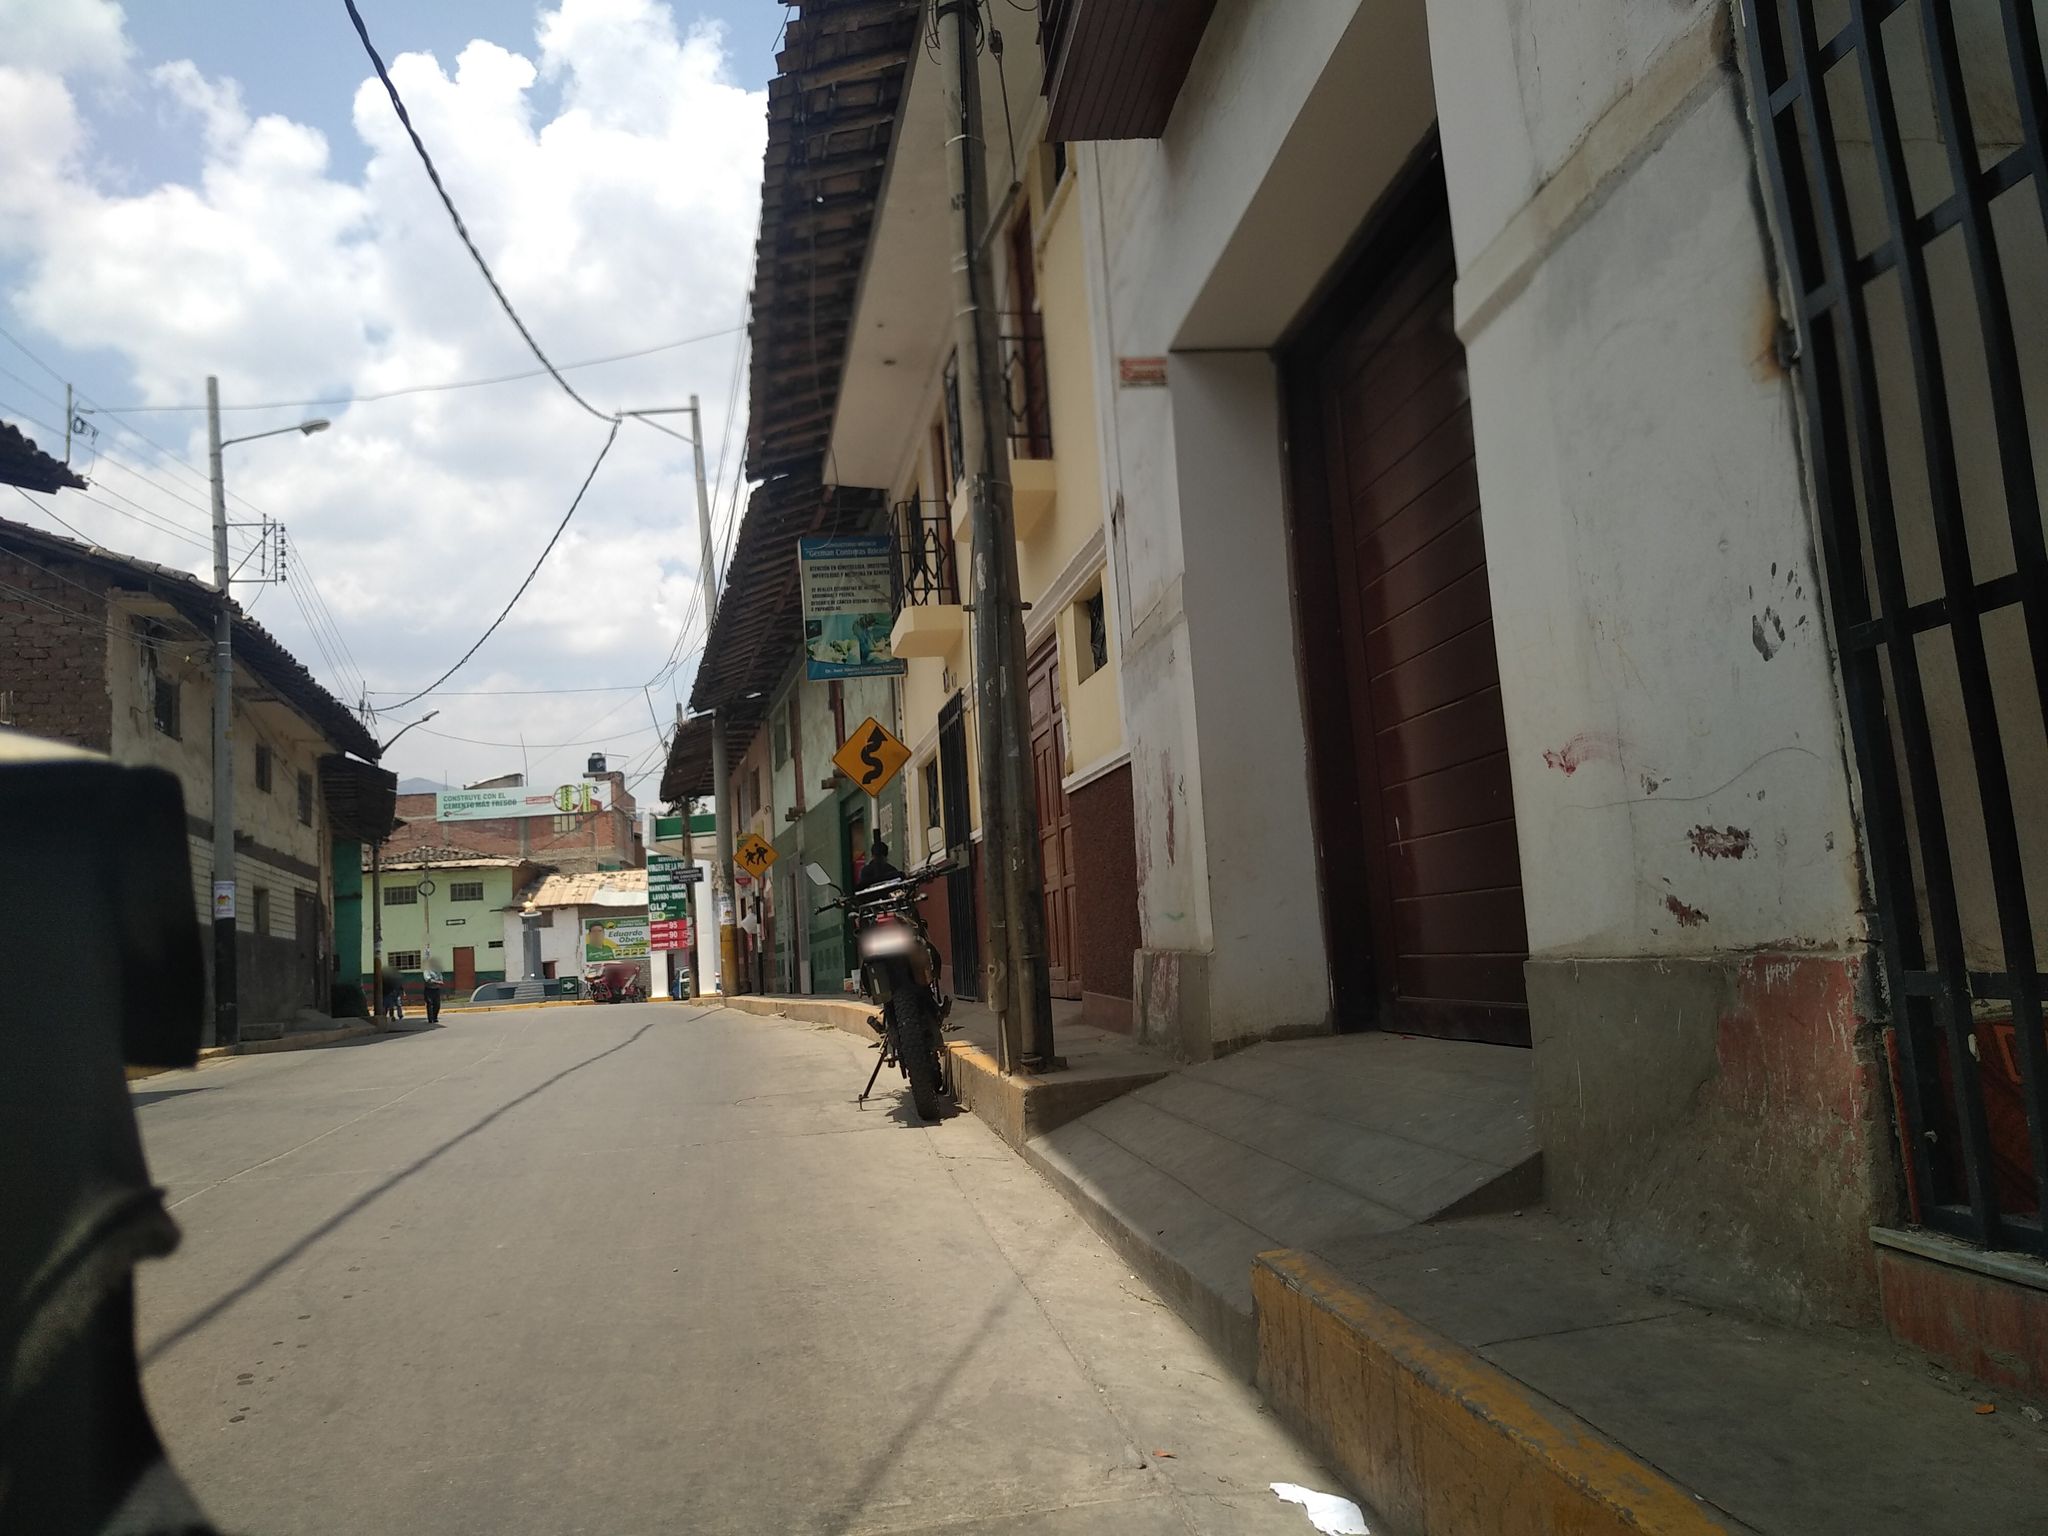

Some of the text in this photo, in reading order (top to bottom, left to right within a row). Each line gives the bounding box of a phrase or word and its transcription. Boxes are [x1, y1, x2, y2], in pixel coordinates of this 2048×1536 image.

[443, 794, 481, 802] CONSTRUYE
[650, 902, 668, 911] GLP
[669, 921, 678, 930] 95
[608, 930, 643, 938] Eduardo
[669, 930, 678, 939] 90
